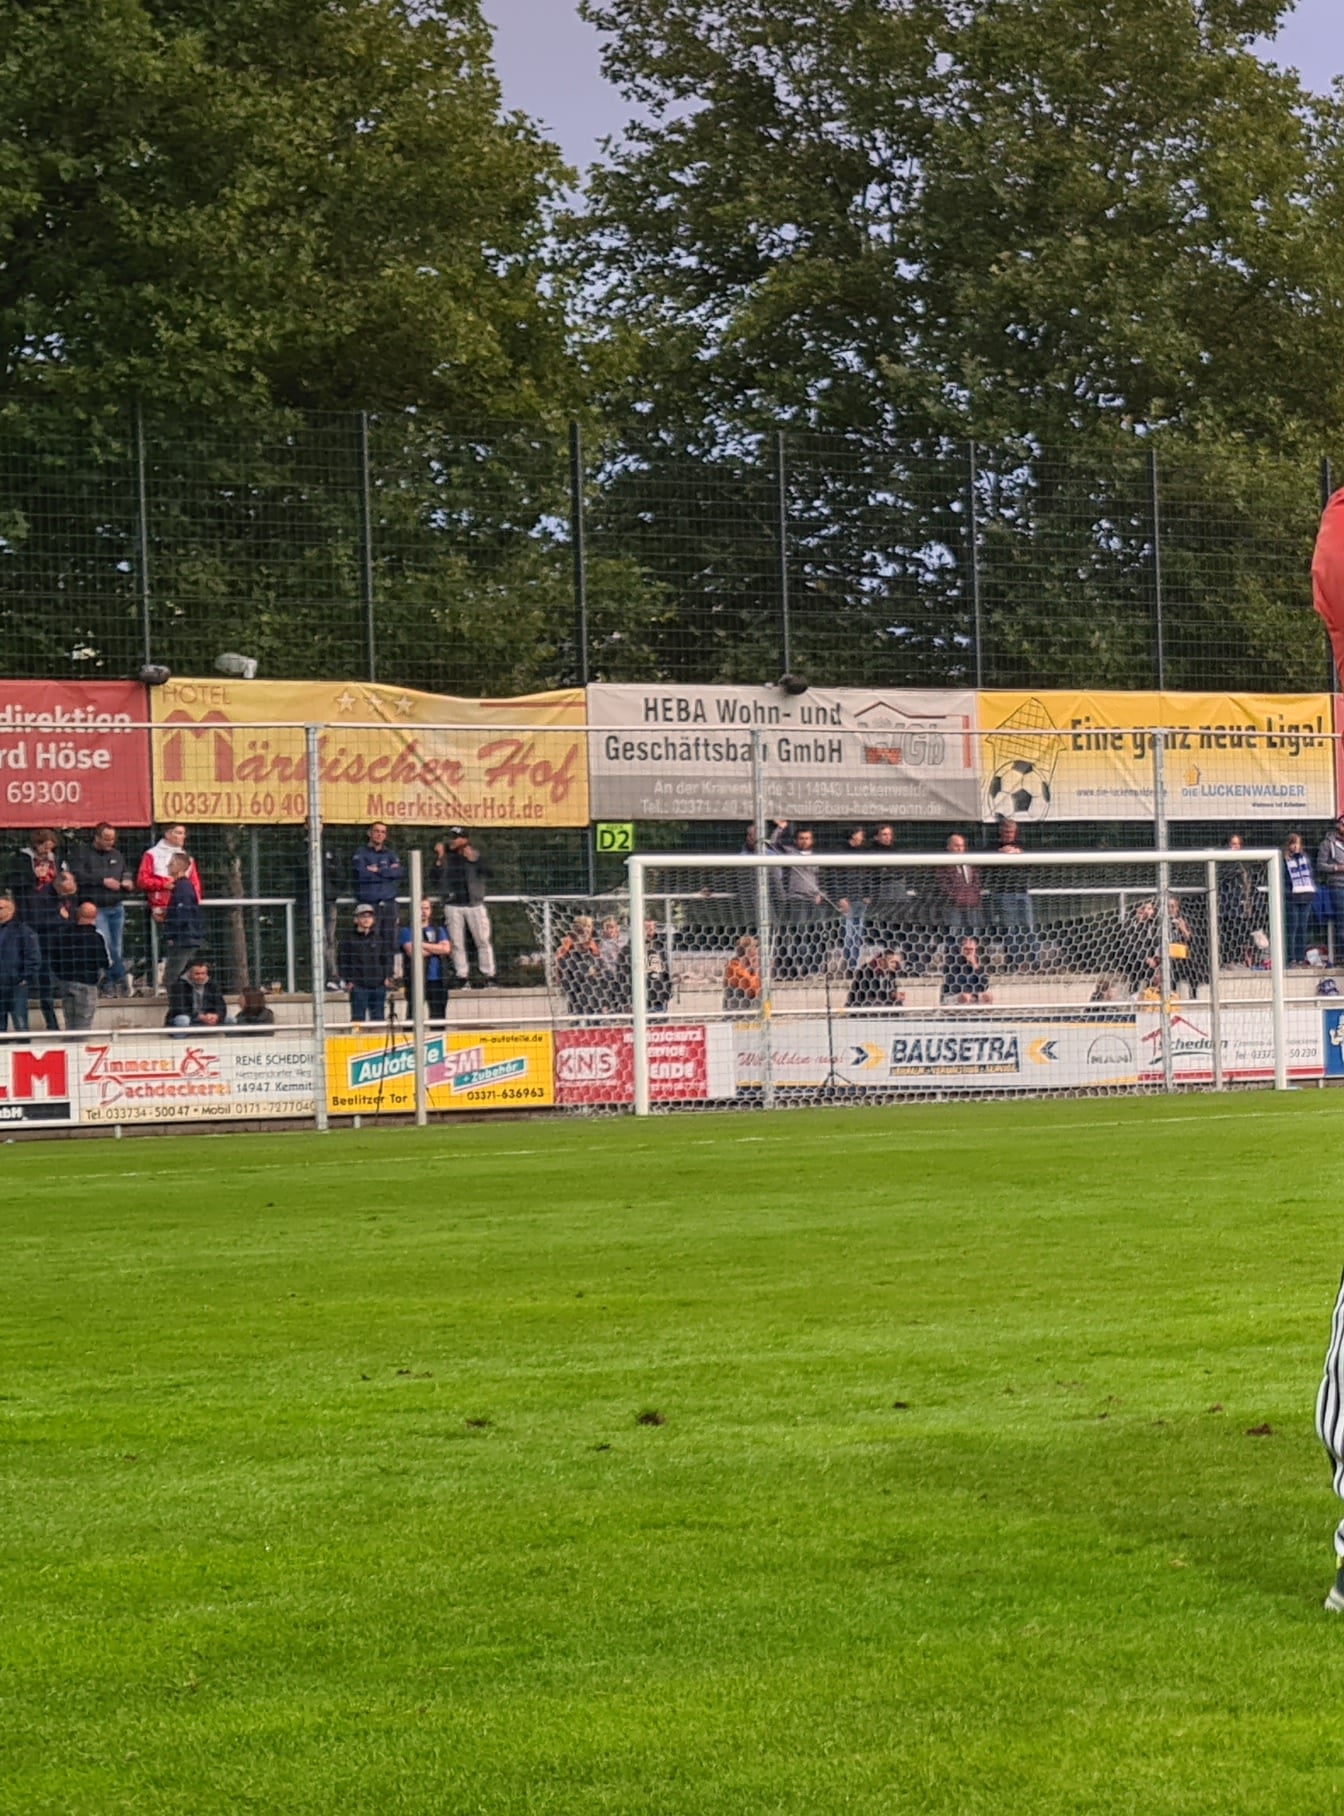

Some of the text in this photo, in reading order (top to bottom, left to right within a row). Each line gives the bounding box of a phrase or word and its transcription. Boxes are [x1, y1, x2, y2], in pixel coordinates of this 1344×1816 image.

[162, 685, 232, 705] HOTEL
[643, 697, 842, 727] HEBA Wohn- und
[1070, 717, 1123, 751] Eine
[1199, 722, 1257, 750] neue
[1266, 714, 1325, 757] Liga!
[36, 741, 111, 769] Höse
[777, 738, 843, 765] GmbH
[477, 738, 580, 804] Hof
[6, 780, 81, 803] 69300
[162, 790, 242, 817] (03371)
[250, 792, 275, 815] 60
[1200, 784, 1305, 798] LUCKENWALDER
[367, 793, 545, 820] MaerkischerHof.de
[600, 829, 630, 850] D2
[892, 1036, 1019, 1063] BAUSETRA
[358, 1046, 440, 1083] Autotele
[444, 1051, 480, 1078] SM
[471, 1062, 519, 1083] Zubehör
[558, 1052, 614, 1074] KNS
[236, 1081, 313, 1093] 14947 Kemnit
[389, 1093, 407, 1104] Tor
[467, 1087, 545, 1101] 03371-636963
[105, 1108, 147, 1119] 033734
[202, 1104, 231, 1114] Mobil
